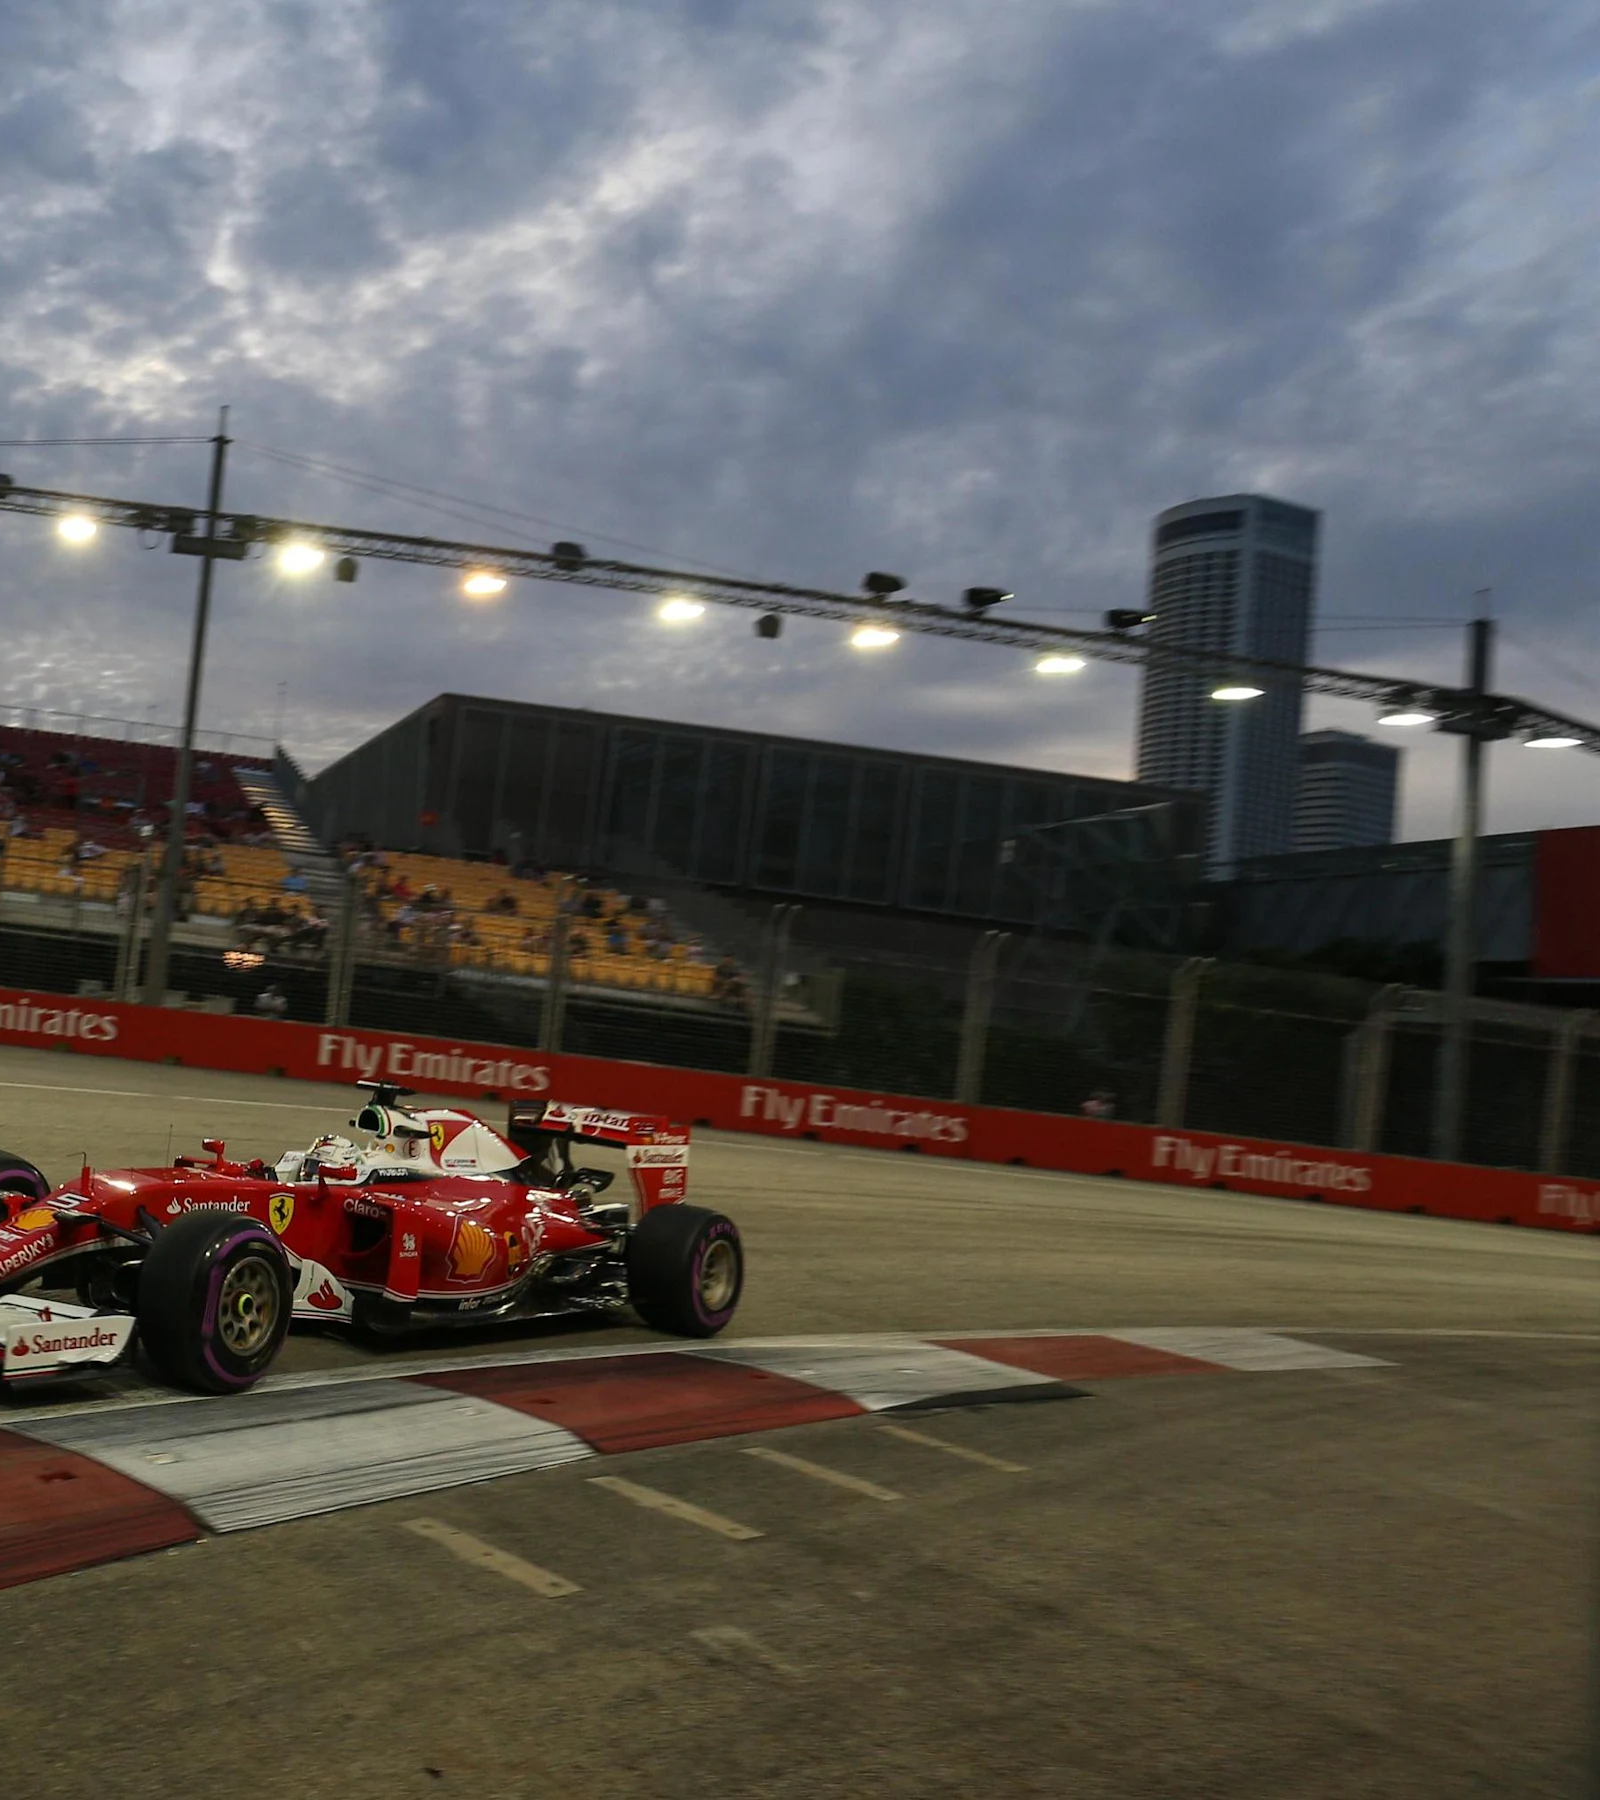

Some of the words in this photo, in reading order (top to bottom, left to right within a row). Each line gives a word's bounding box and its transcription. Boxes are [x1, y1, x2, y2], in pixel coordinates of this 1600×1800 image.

[317, 1034, 384, 1078] Fly
[386, 1043, 550, 1091] Emirates
[740, 1085, 805, 1129] Fly
[809, 1094, 969, 1142] Emirates
[1152, 1136, 1218, 1179] Fly
[1217, 1145, 1372, 1192] Emirates
[46, 1192, 92, 1209] 5
[183, 1195, 251, 1213] Santander
[343, 1198, 380, 1218] Claro
[31, 1326, 118, 1355] Santander
